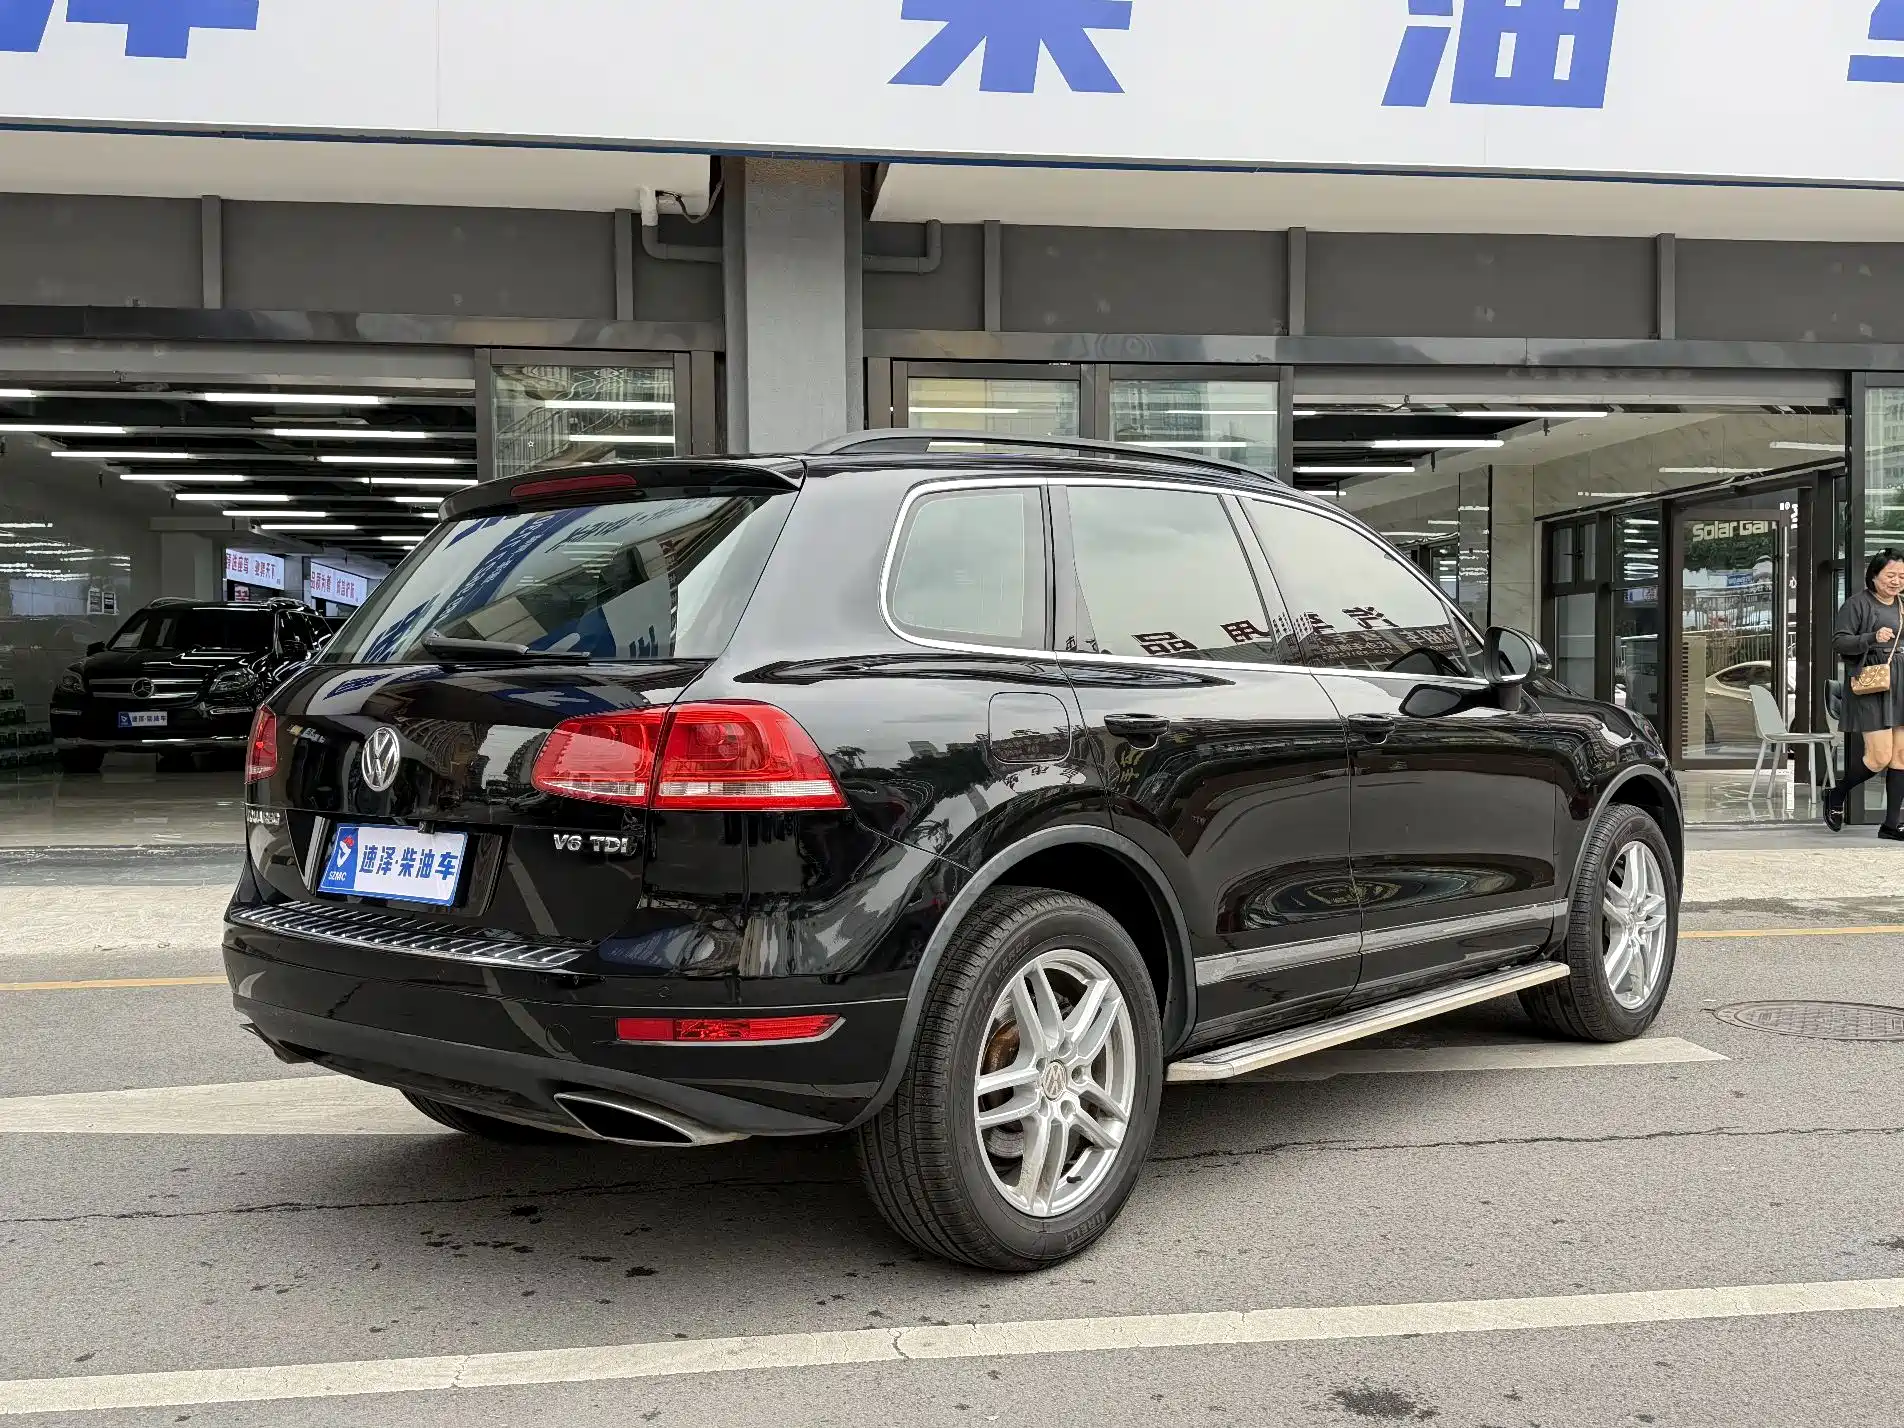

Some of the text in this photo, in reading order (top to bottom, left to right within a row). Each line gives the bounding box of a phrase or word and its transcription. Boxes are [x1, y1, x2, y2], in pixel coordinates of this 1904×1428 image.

[1692, 520, 1738, 542] Solar
[553, 833, 629, 853] V6 TDI
[327, 870, 347, 881] SZMC
